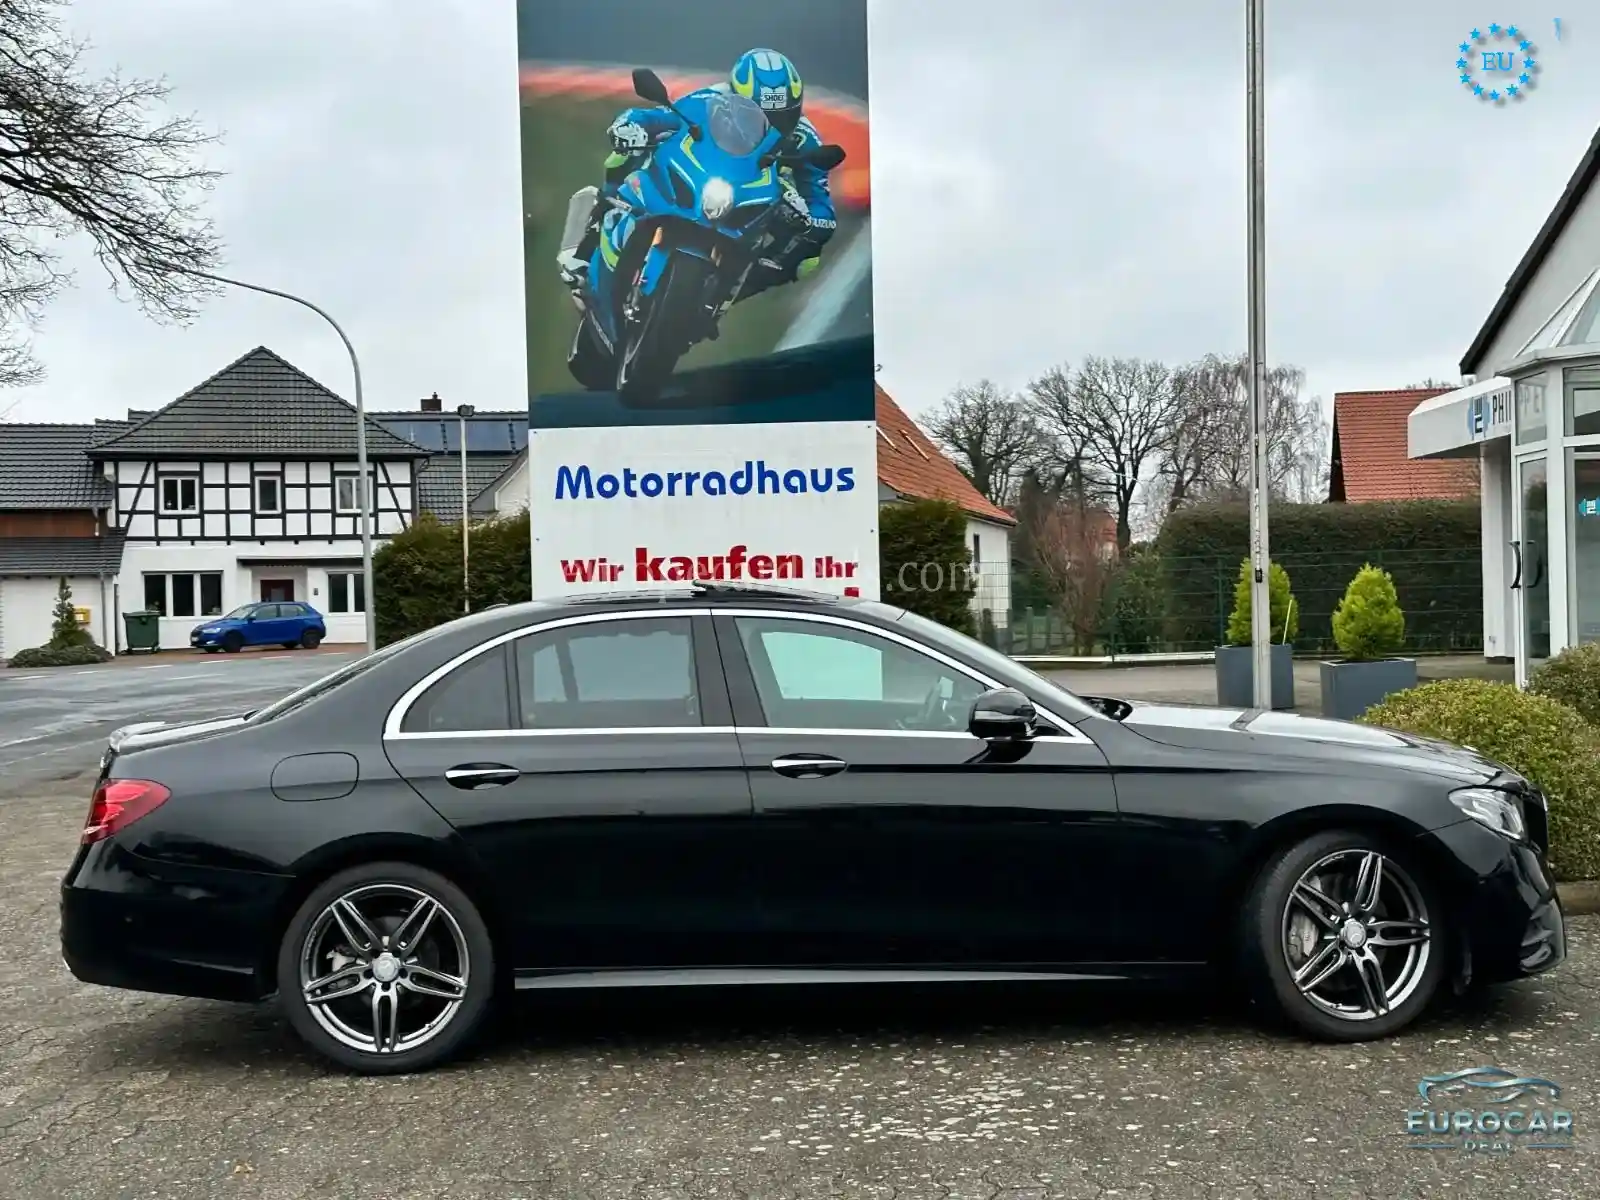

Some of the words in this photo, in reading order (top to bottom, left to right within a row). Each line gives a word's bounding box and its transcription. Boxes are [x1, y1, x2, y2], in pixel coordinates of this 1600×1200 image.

[555, 460, 856, 500] Motorradhaus
[560, 557, 625, 583] Wir
[634, 545, 804, 582] kaufen
[814, 555, 857, 579] Ihr
